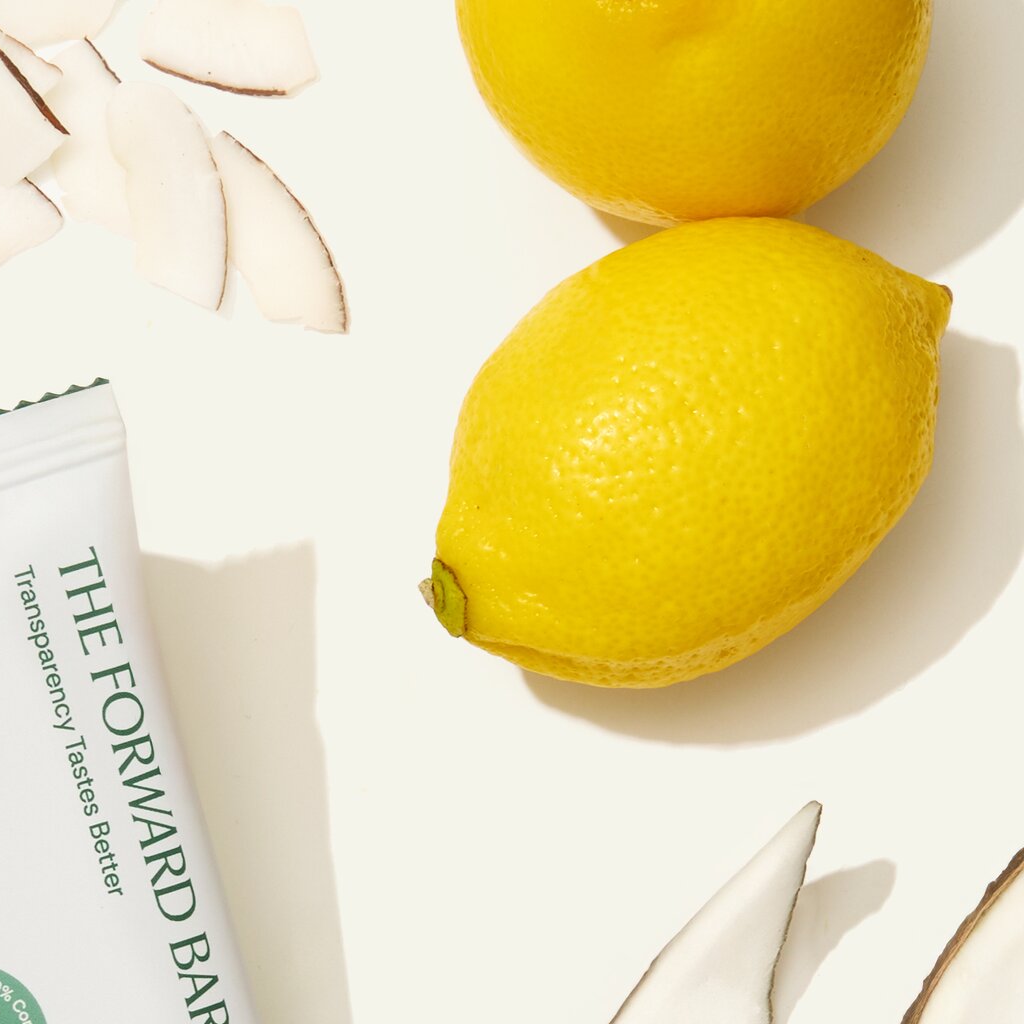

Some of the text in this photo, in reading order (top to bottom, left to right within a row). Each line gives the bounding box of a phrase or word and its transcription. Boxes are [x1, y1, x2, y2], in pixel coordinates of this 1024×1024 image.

[14, 564, 124, 896] Transparency Tastes Better
[58, 545, 124, 656] THE
[90, 661, 197, 922] FORWARD
